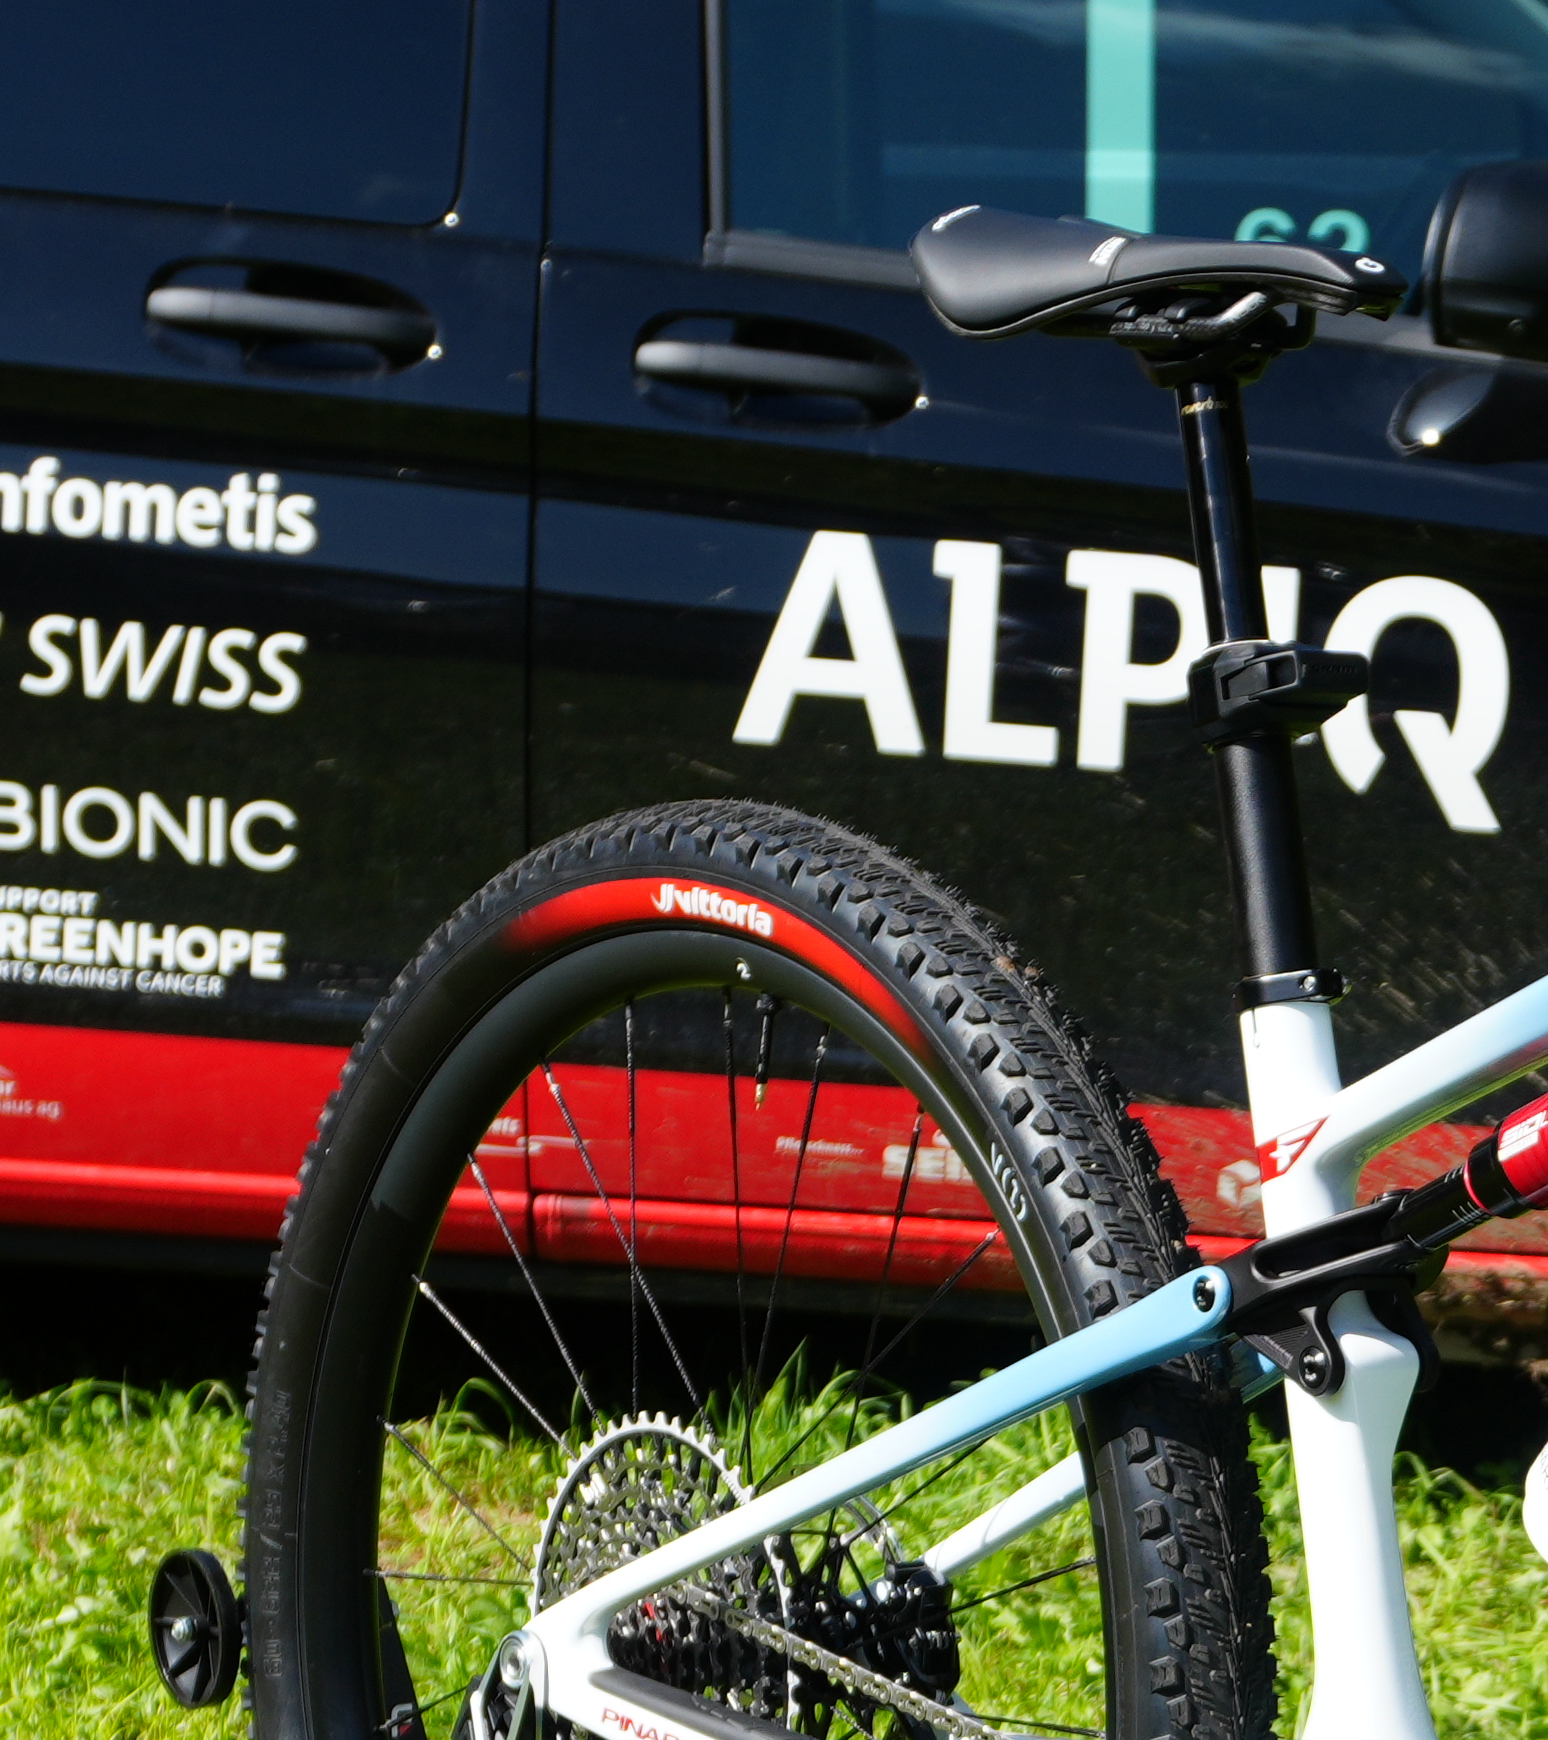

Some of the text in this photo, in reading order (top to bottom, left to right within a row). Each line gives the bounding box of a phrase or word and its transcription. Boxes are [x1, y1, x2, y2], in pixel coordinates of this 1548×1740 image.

[20, 614, 308, 714] SWISS
[674, 886, 773, 937] vittoria
[39, 962, 134, 991] AGAINST
[136, 972, 225, 999] CANCER
